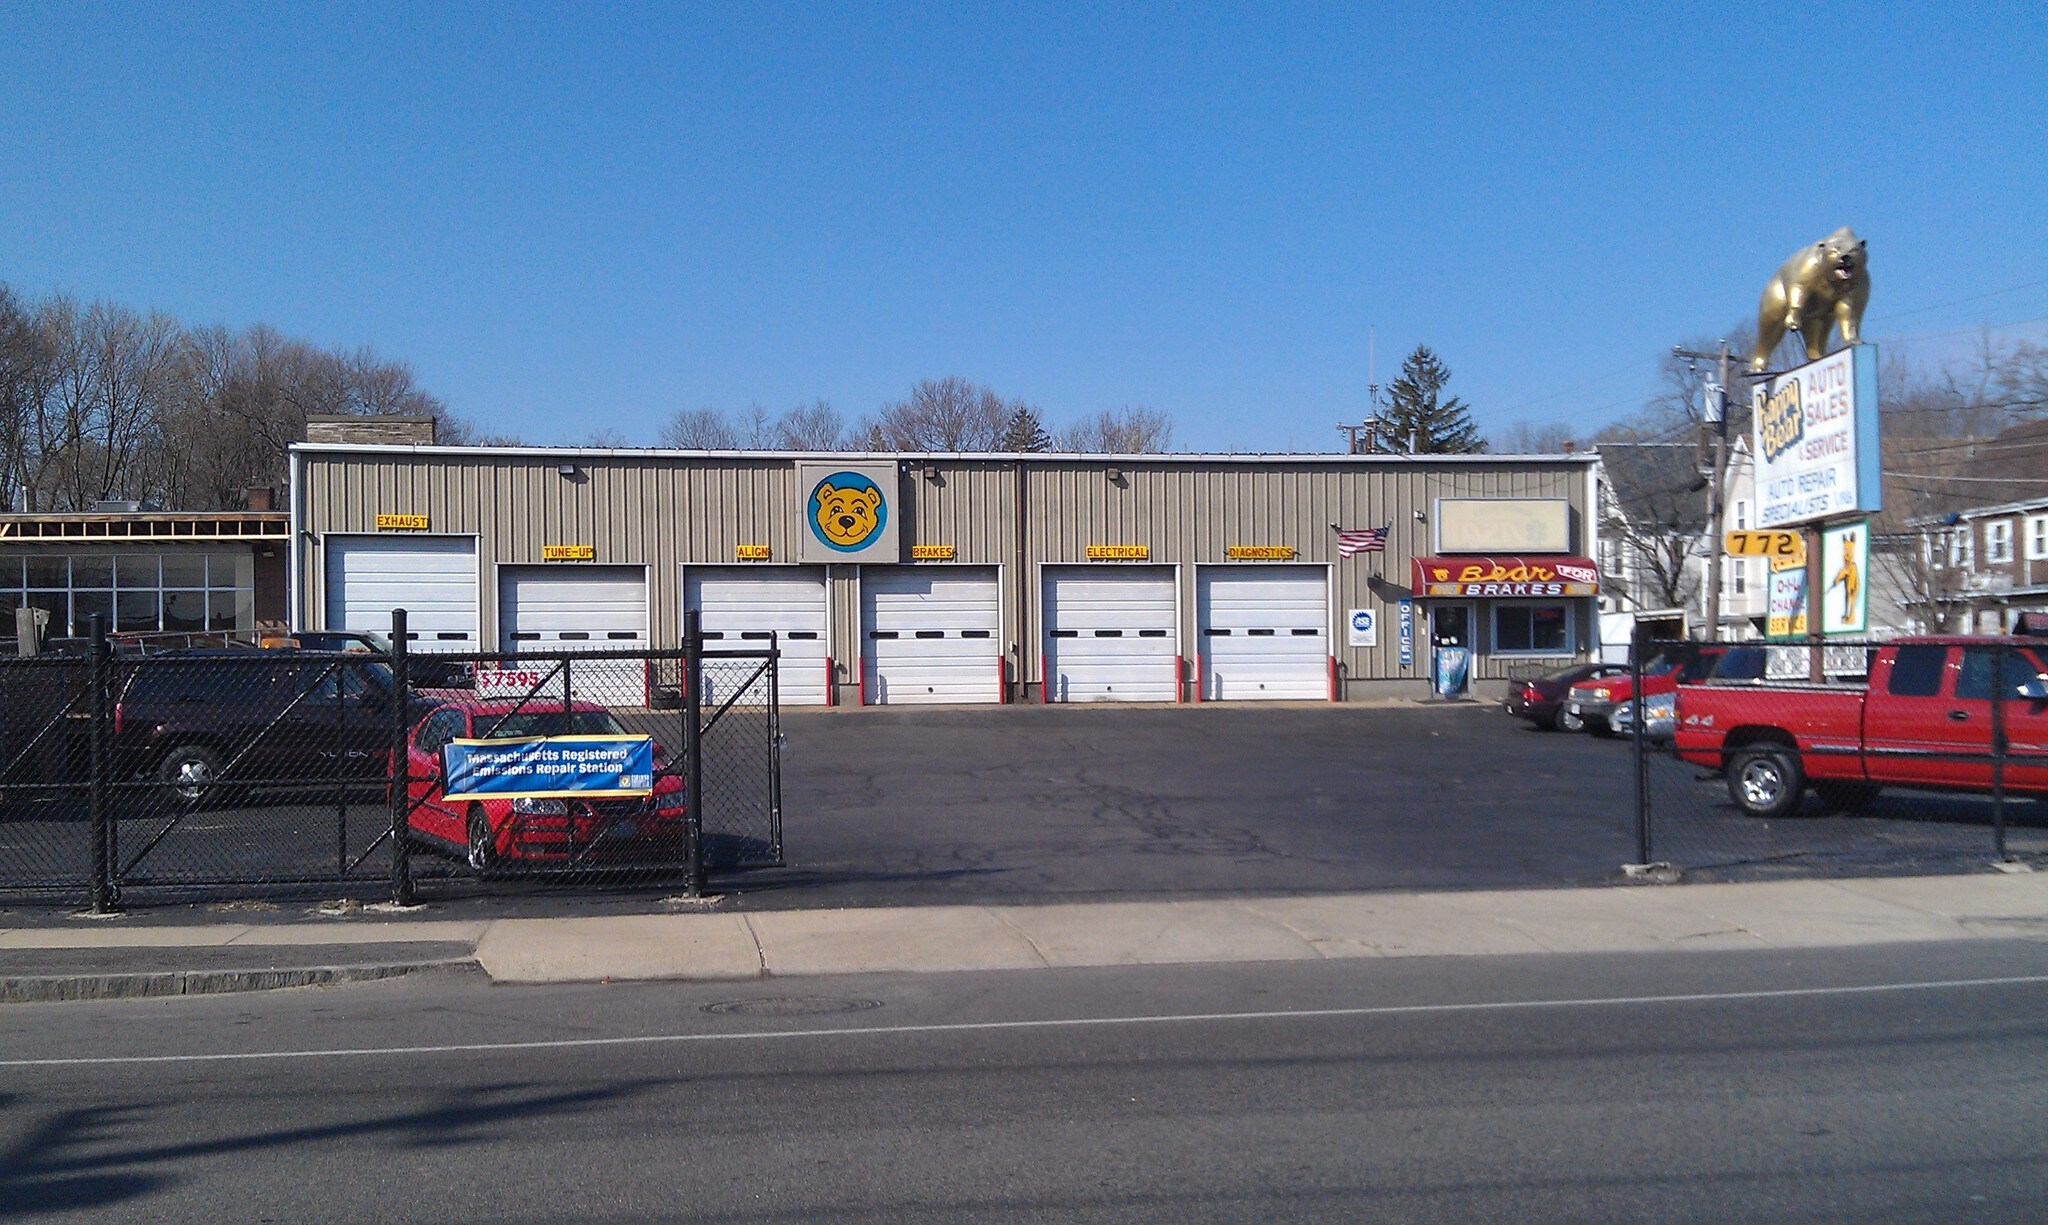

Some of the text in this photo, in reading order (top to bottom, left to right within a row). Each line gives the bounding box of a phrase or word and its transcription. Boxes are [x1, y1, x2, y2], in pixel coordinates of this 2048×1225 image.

[1807, 361, 1845, 398] AUTO
[1806, 390, 1848, 428] SALES
[1806, 430, 1848, 460] SERVICE
[1798, 466, 1837, 494] REPAIR
[377, 516, 427, 527] EXHAUST
[738, 546, 768, 557] ALIGN
[1087, 547, 1147, 557] ELECTRICAL
[1733, 534, 1793, 555] 772
[544, 547, 593, 558] TUNE-UP
[913, 547, 953, 558] BRAKES
[1229, 547, 1292, 558] DIAGNOSTICS
[1458, 565, 1555, 583] Bear
[1465, 584, 1562, 595] BRAKES
[1771, 615, 1806, 632] SERCE
[467, 749, 628, 764] Massachusetts Registered
[472, 761, 623, 777] Emissions Repair Station
